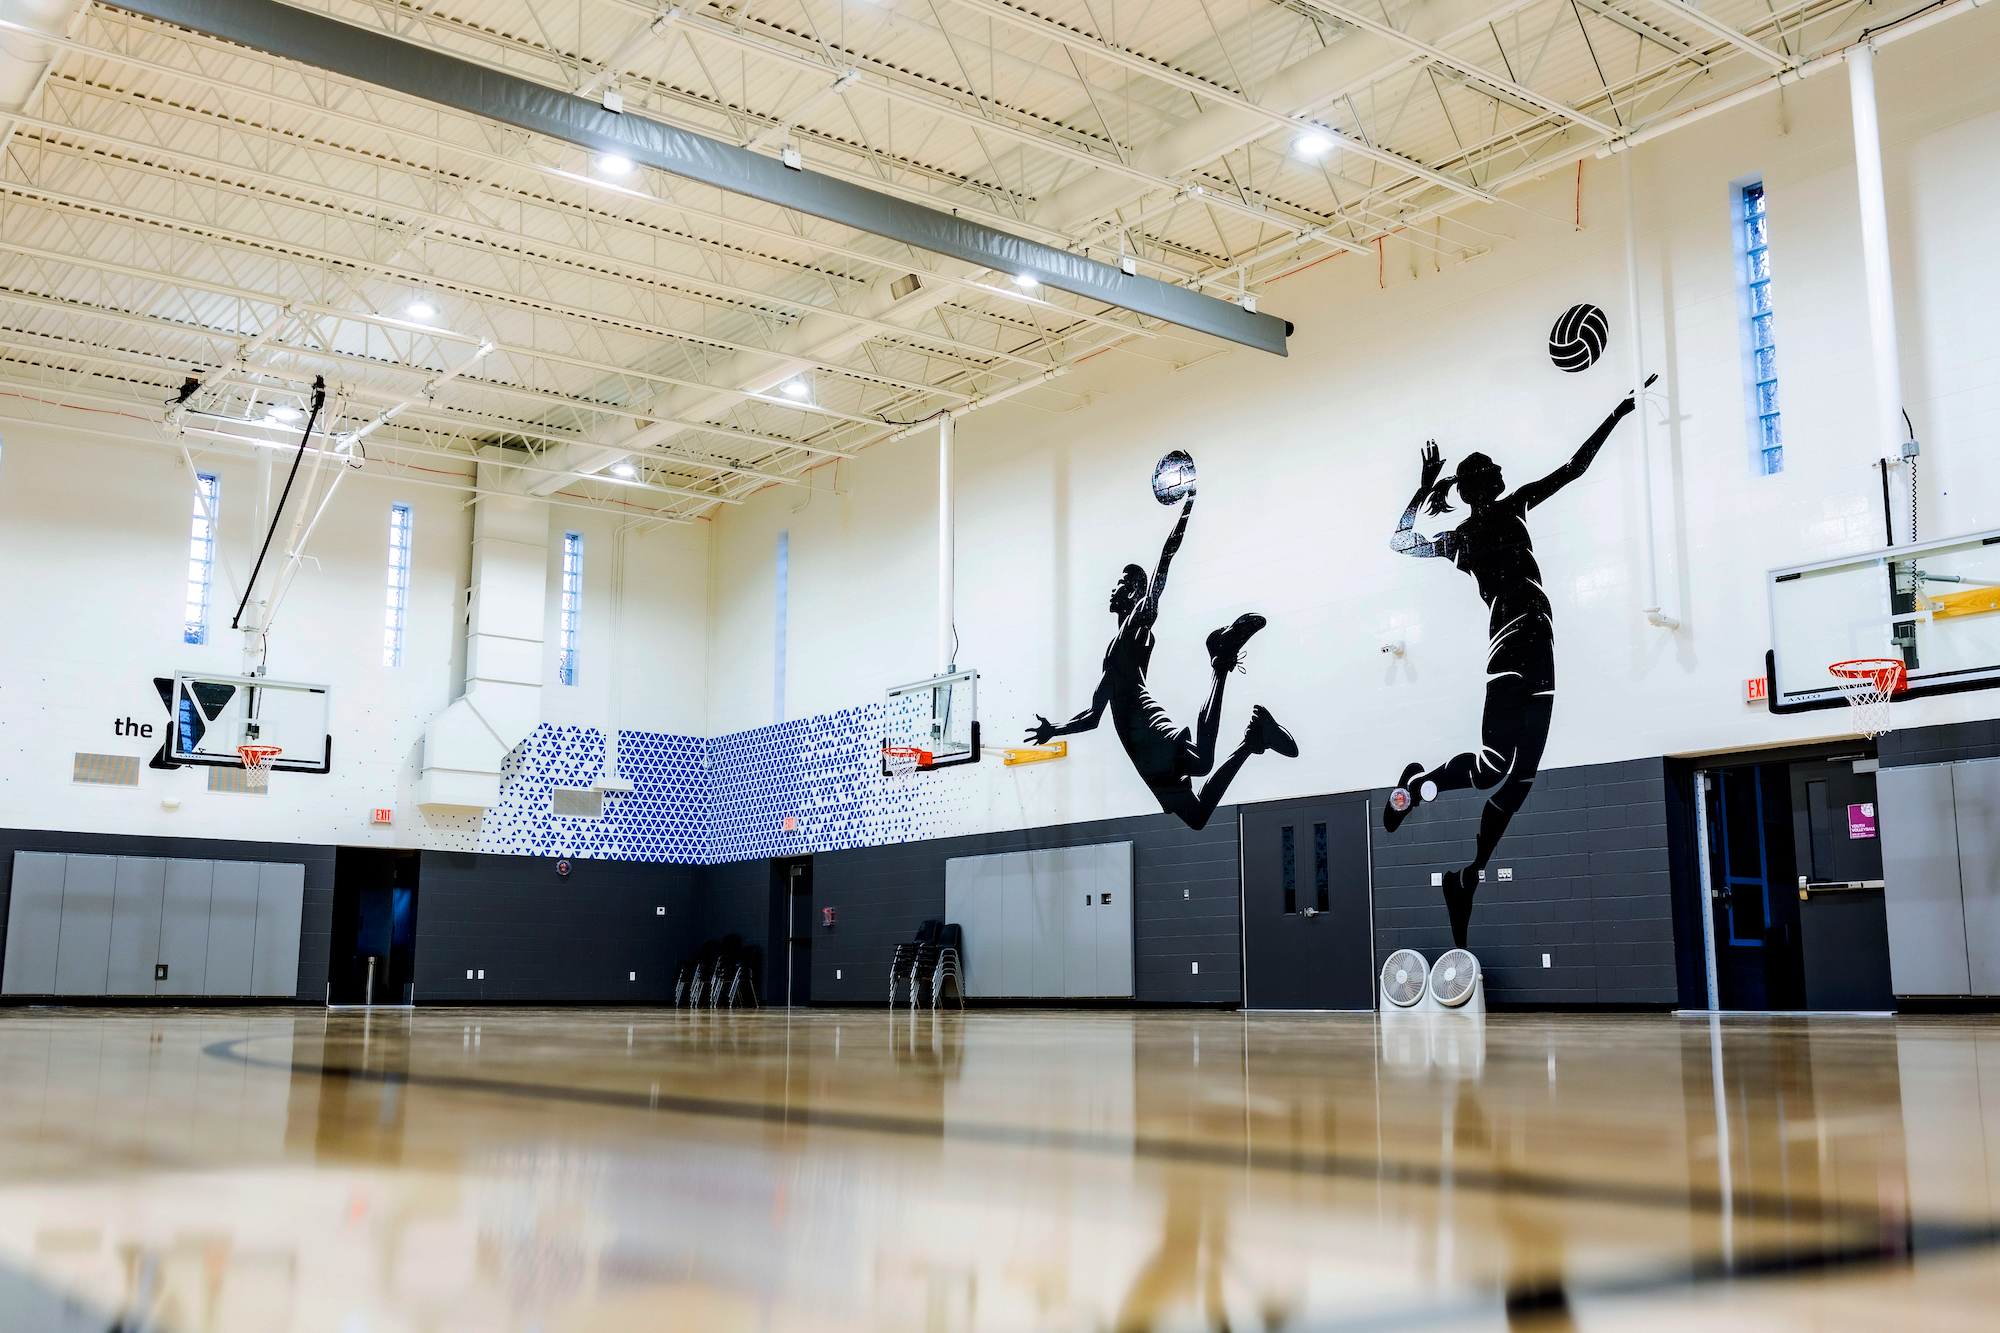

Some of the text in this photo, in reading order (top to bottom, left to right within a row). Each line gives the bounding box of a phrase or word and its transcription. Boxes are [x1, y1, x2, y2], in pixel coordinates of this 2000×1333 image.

[1748, 678, 1768, 698] EXI
[1788, 693, 1821, 702] AALCO
[114, 716, 153, 738] the
[375, 808, 391, 821] EXIT
